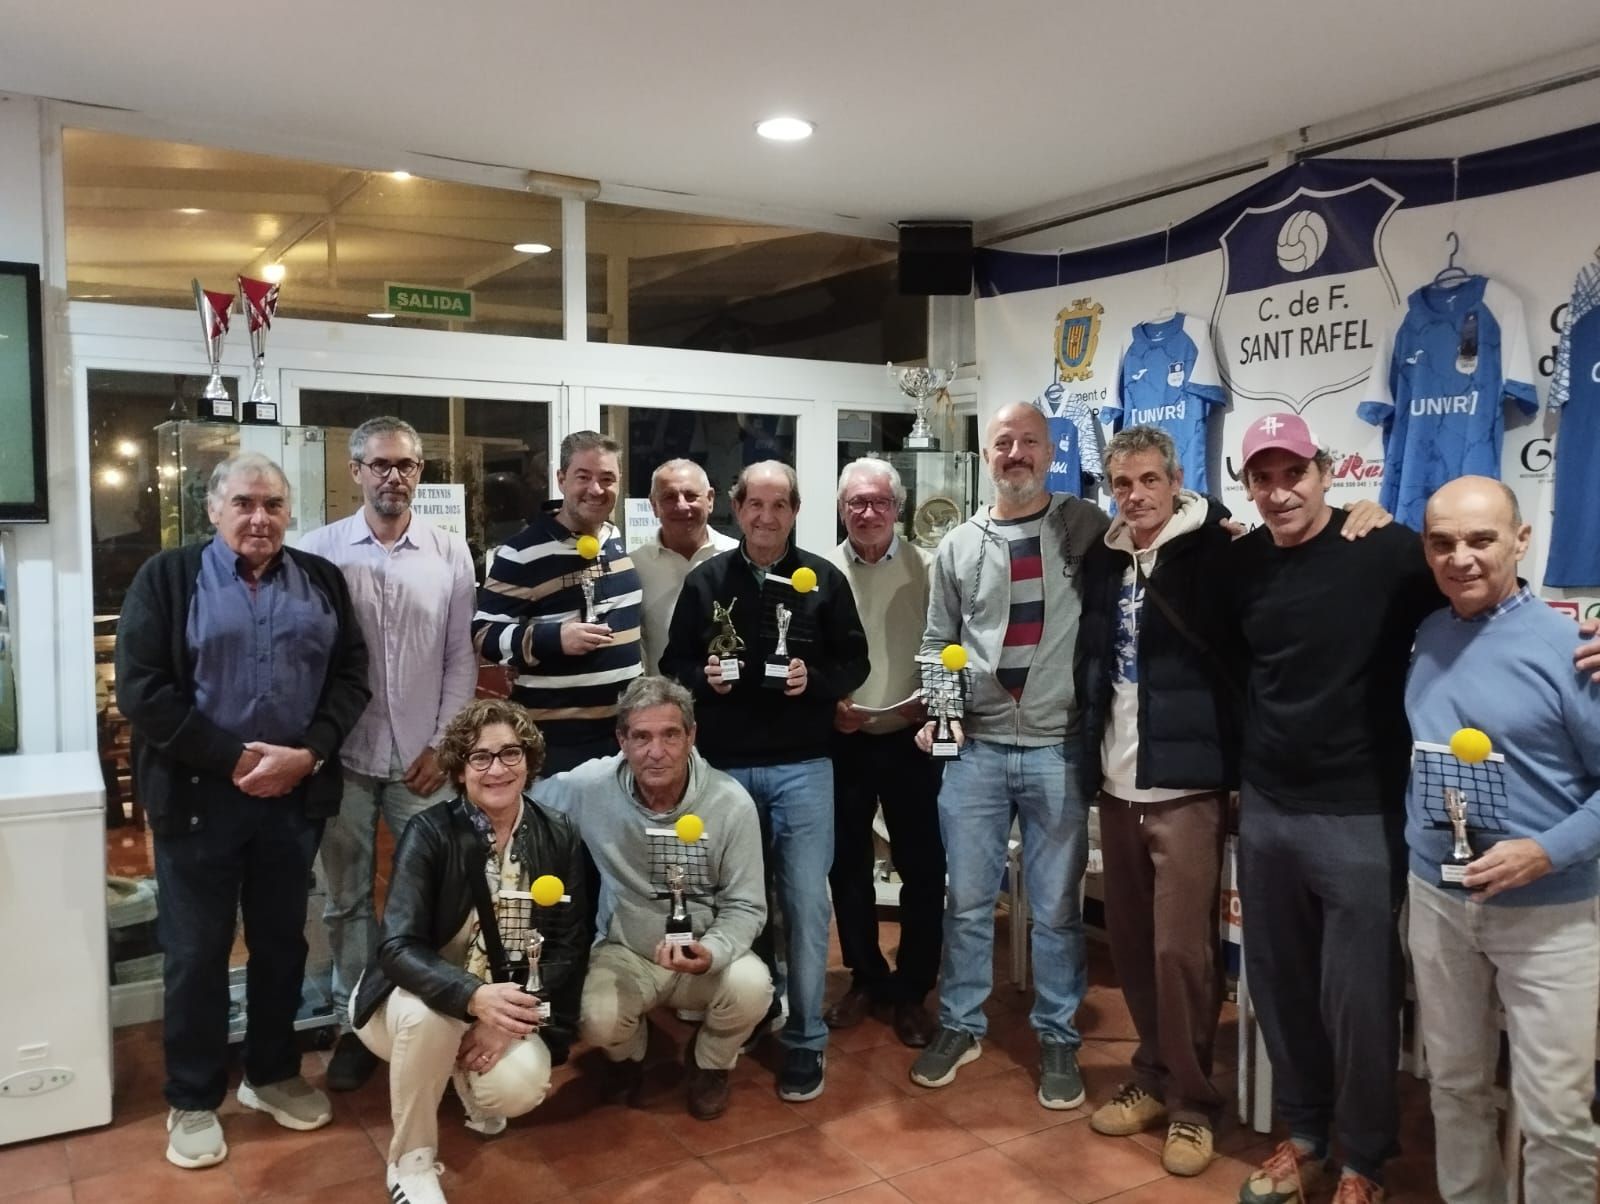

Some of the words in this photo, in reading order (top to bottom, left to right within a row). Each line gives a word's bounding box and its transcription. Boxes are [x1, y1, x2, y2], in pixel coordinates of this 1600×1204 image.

[397, 292, 464, 311] SALIDA
[1258, 297, 1280, 322] C.
[1288, 289, 1320, 317] de
[1329, 284, 1349, 311] F.
[1239, 329, 1294, 365] SANT
[1300, 319, 1374, 356] RAFEL
[427, 488, 452, 499] TENNIS
[424, 504, 444, 515] RAFEL
